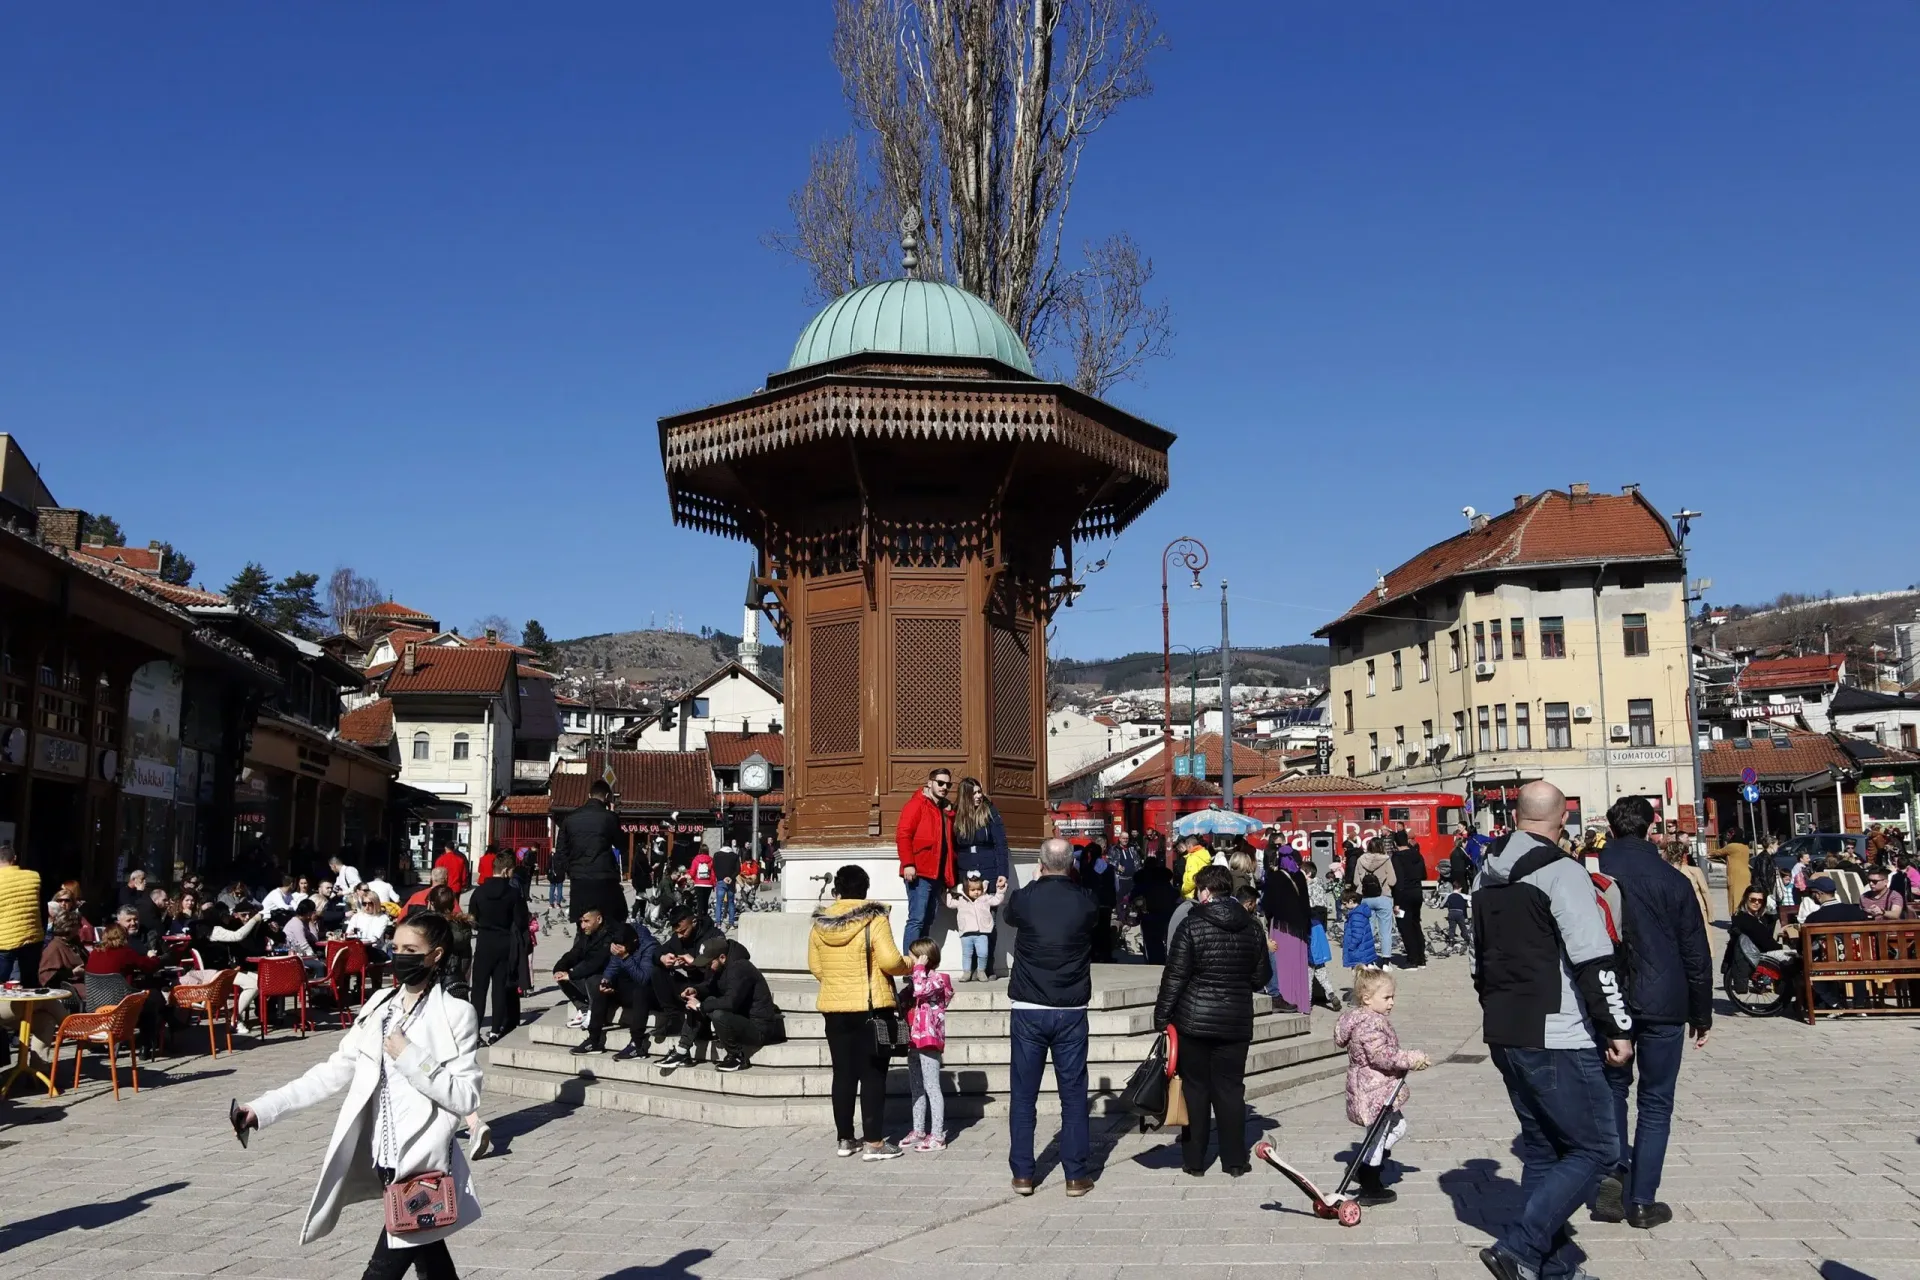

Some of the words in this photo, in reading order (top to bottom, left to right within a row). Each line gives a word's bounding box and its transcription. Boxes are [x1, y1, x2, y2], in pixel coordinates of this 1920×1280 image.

[1732, 707, 1765, 718] HOTEL
[1766, 703, 1801, 716] YILDIZ
[1612, 751, 1667, 760] STOMATOLOG
[734, 811, 782, 822] MENICA
[1343, 822, 1412, 851] Ba
[1598, 969, 1632, 1031] STWD
